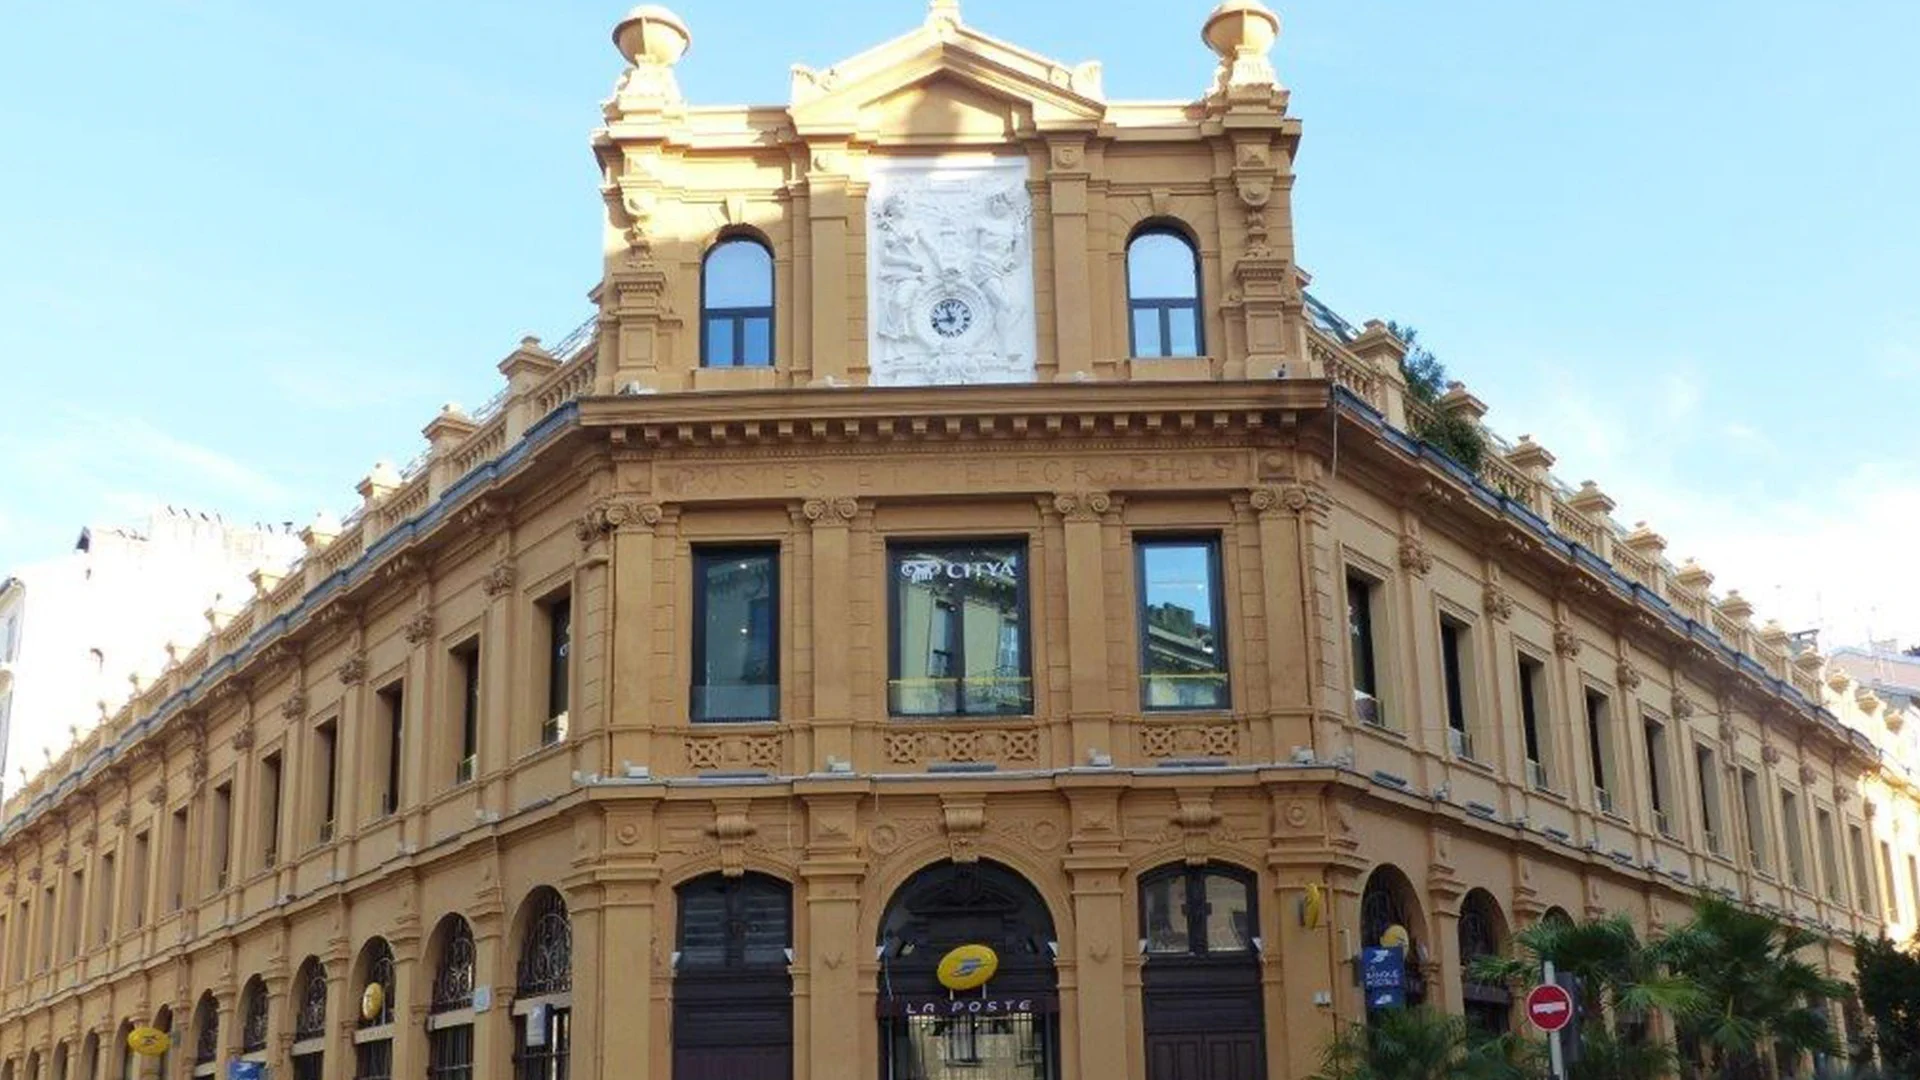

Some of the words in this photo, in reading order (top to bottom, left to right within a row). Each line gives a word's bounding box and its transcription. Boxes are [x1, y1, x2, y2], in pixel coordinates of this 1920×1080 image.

[674, 464, 827, 492] POSTES
[858, 464, 907, 488] ET
[946, 561, 1016, 579] CITYA
[906, 1003, 936, 1014] LA
[951, 1000, 1032, 1013] POSTE
